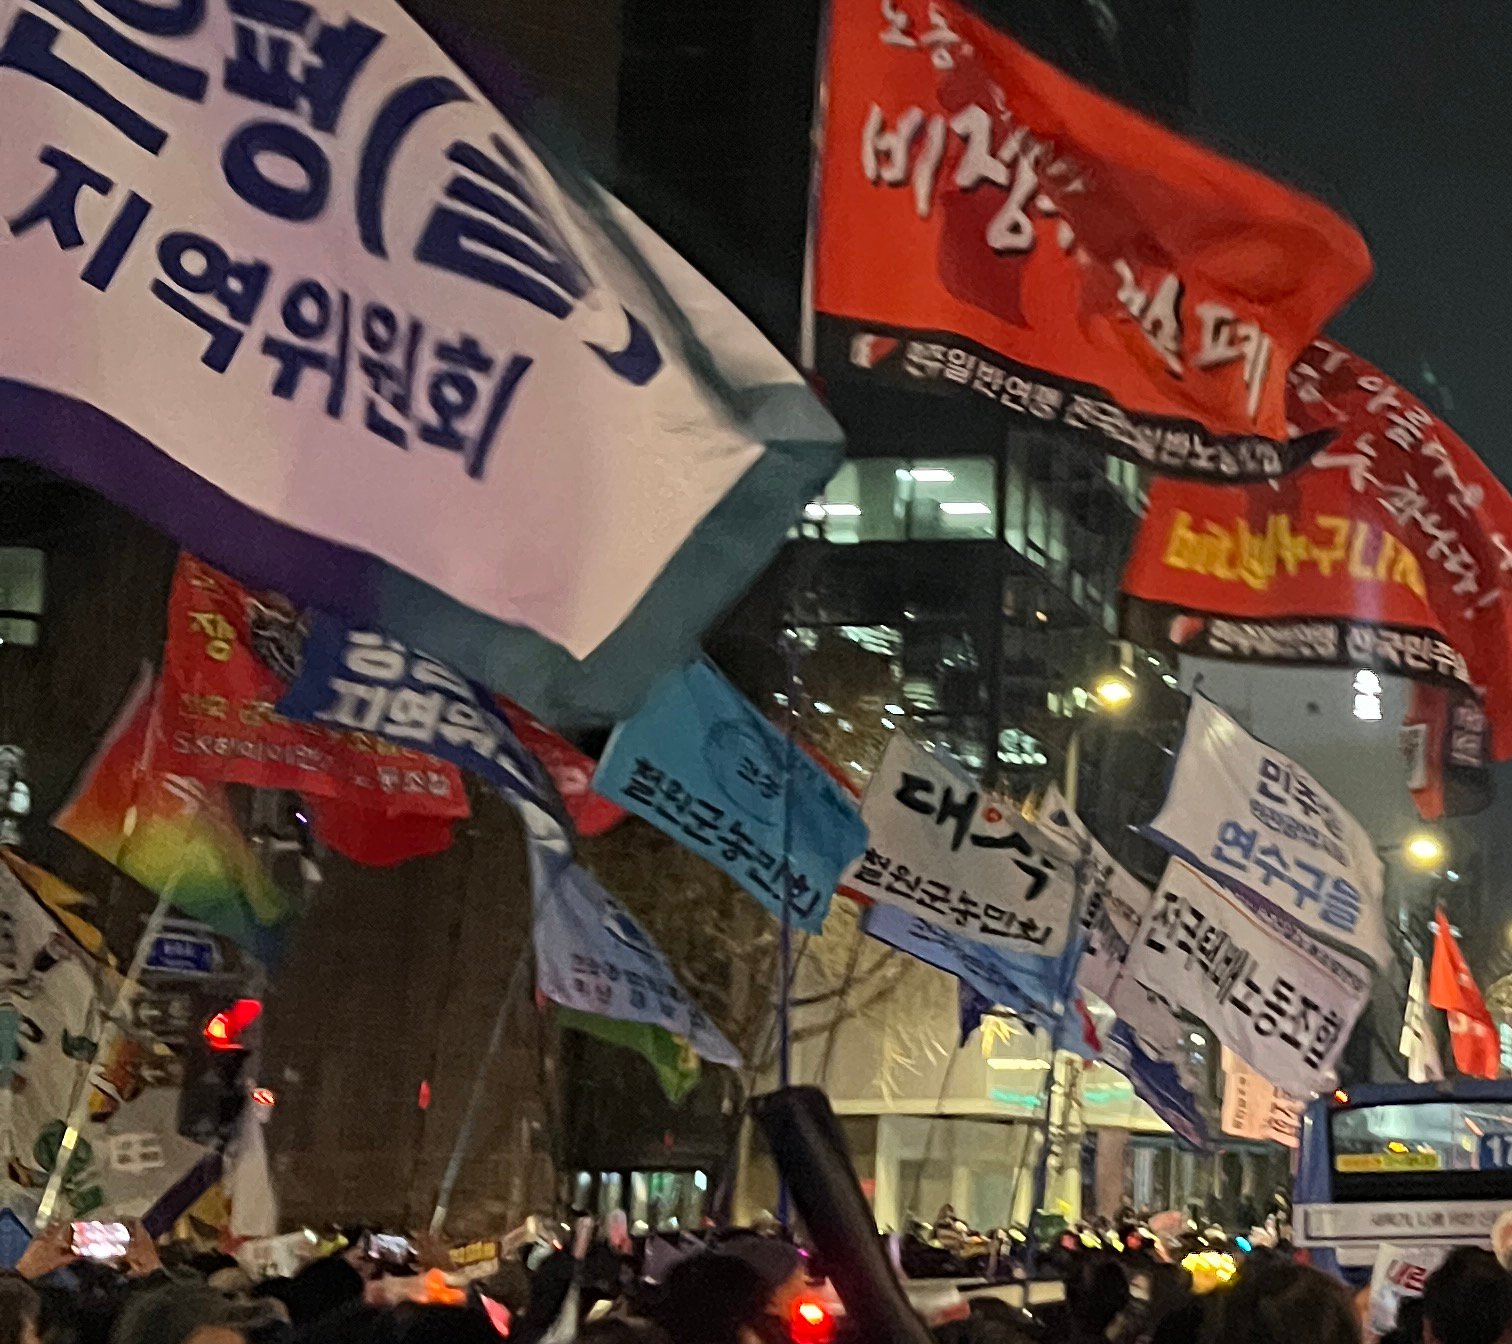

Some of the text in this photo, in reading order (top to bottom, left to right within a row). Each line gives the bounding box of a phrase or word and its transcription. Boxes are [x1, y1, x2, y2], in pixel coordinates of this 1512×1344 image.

[10, 144, 534, 481] 지역위원회
[854, 846, 1053, 946] 철원군농민회
[1210, 819, 1363, 935] 연수구을
